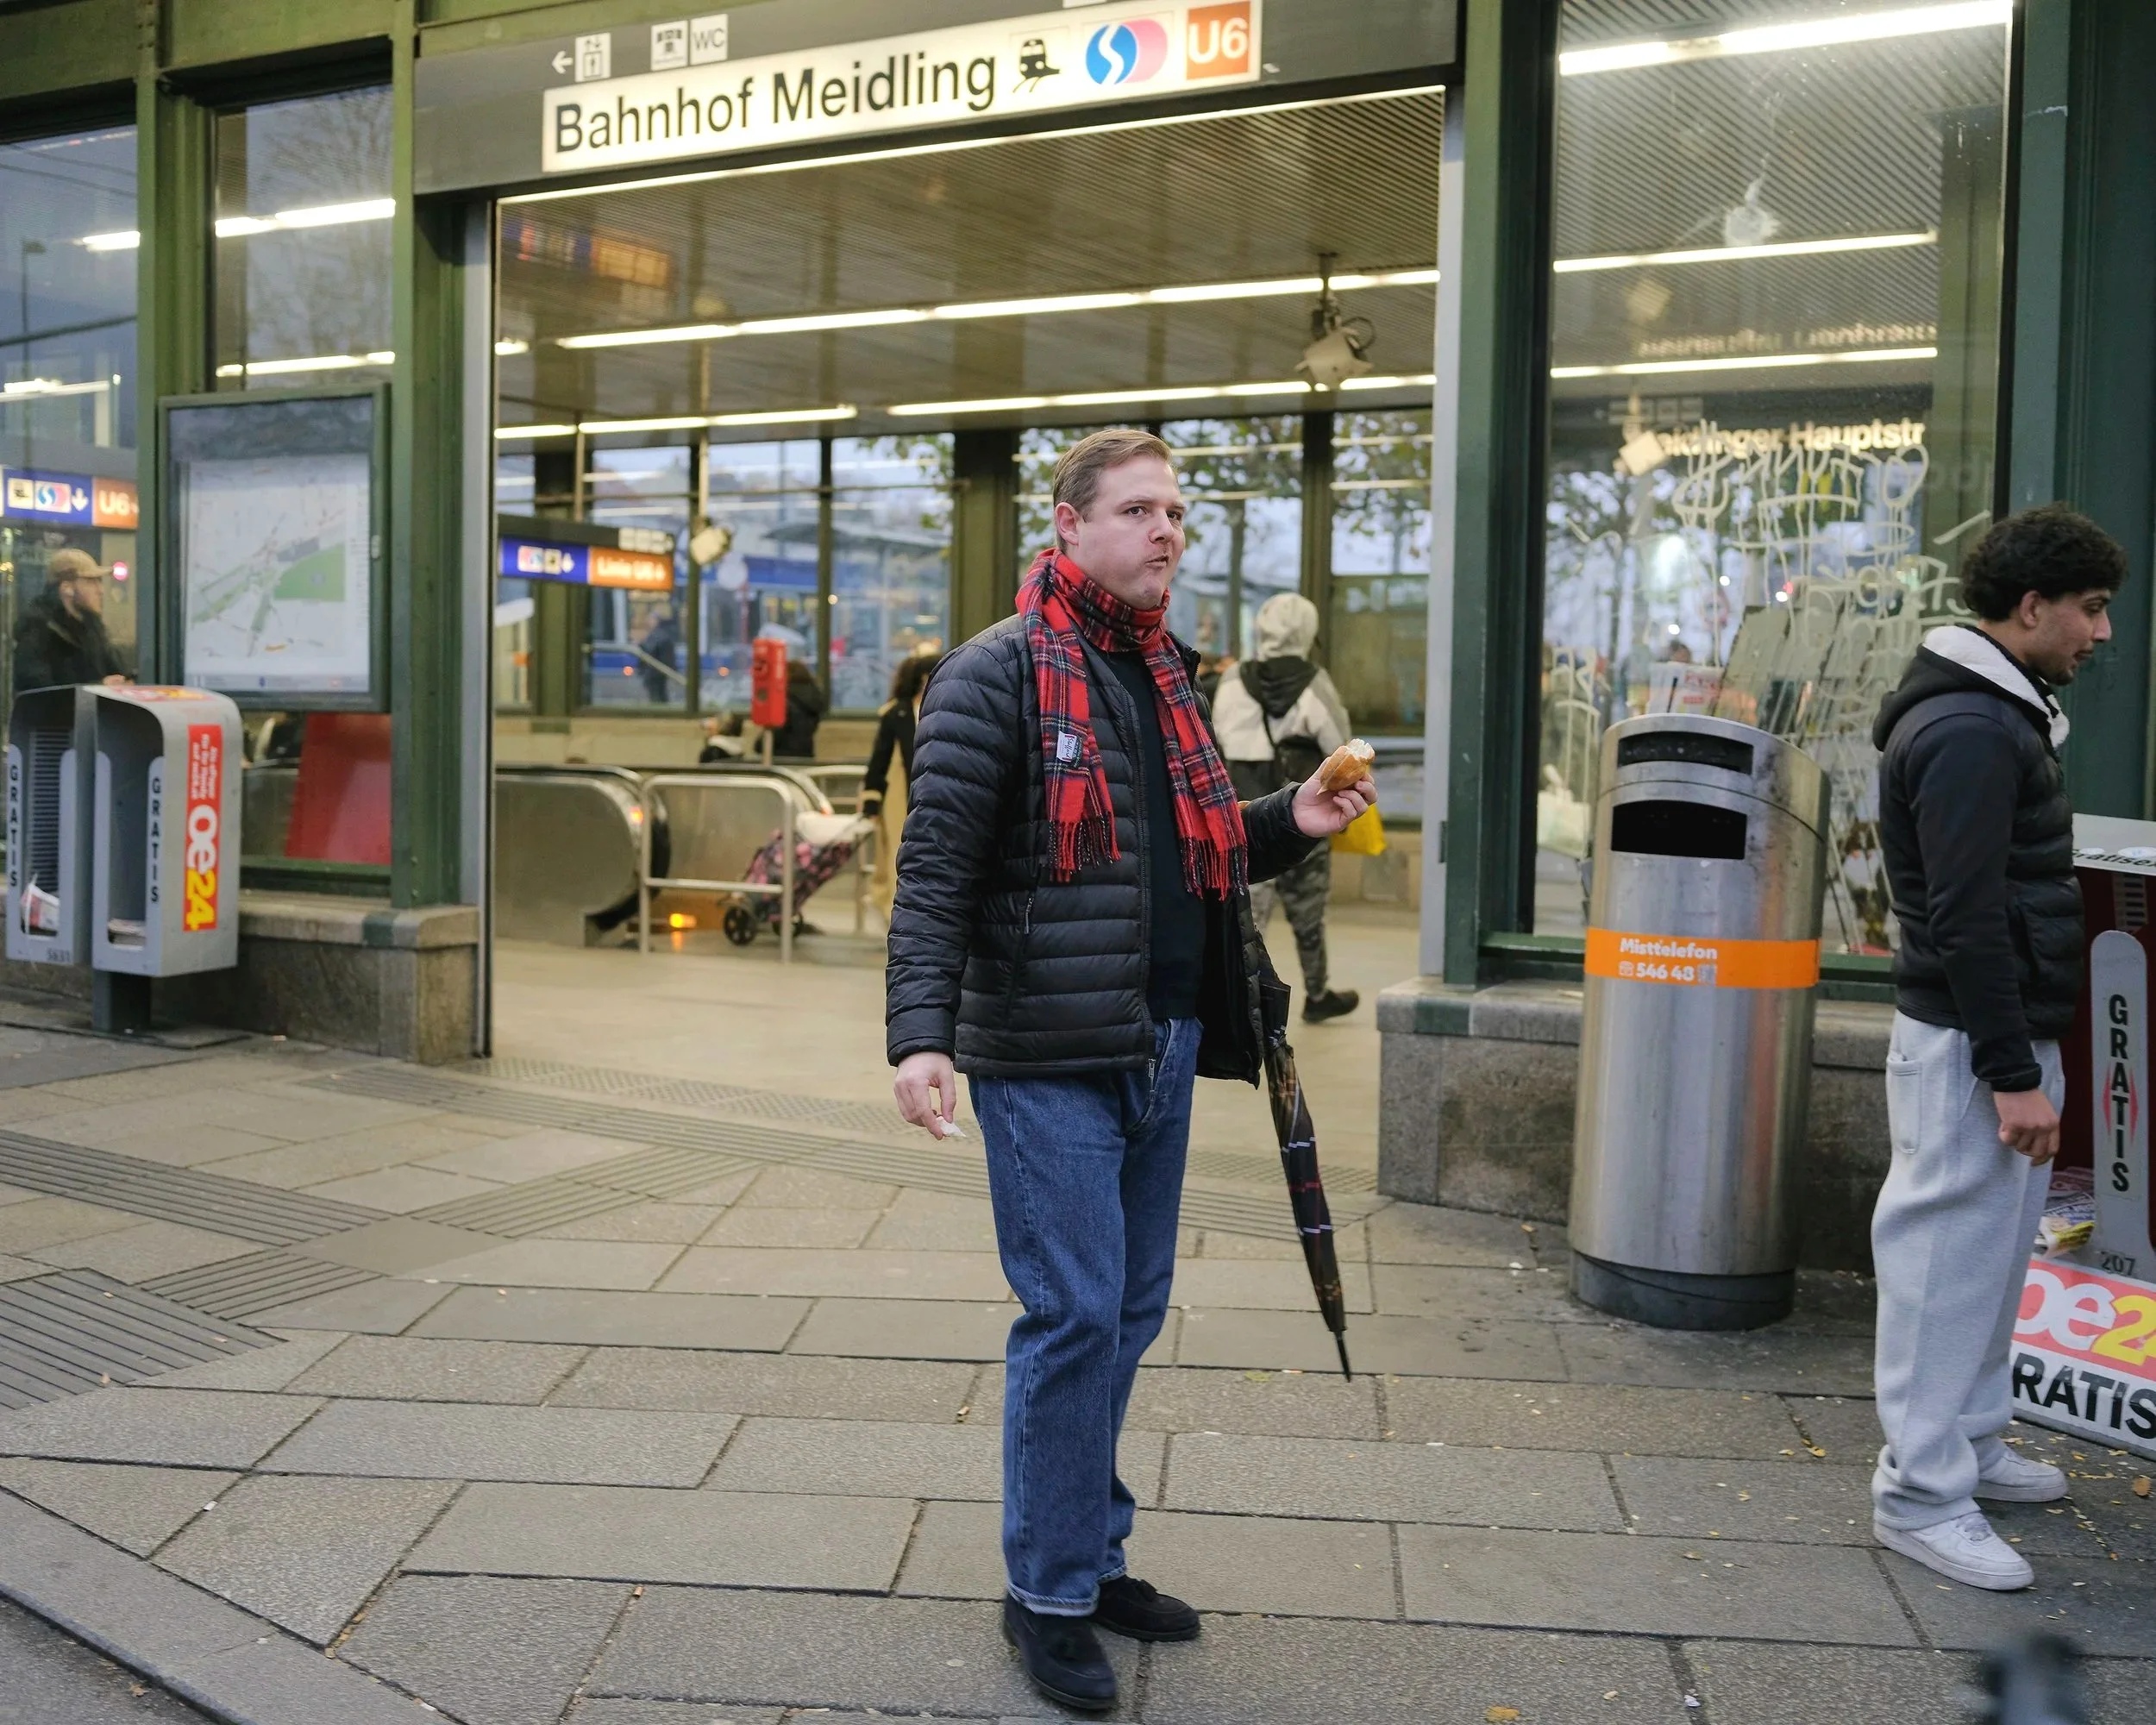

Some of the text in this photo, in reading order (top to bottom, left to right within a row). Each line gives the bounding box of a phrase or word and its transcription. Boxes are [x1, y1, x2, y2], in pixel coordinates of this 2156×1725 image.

[556, 17, 1249, 154] Bahnhof Meidling U6
[693, 28, 725, 51] WC
[99, 489, 130, 517] U6
[9, 765, 19, 888] GRATIS
[151, 778, 161, 903] GRATIS
[186, 805, 217, 932] oe24
[1620, 938, 1718, 960] Misttelefon
[1637, 963, 1695, 982] 546 48
[2109, 994, 2129, 1193] GRATIS
[2100, 1251, 2136, 1276] 207
[2014, 1268, 2156, 1366] oe2
[2012, 1352, 2156, 1440] RATIS
